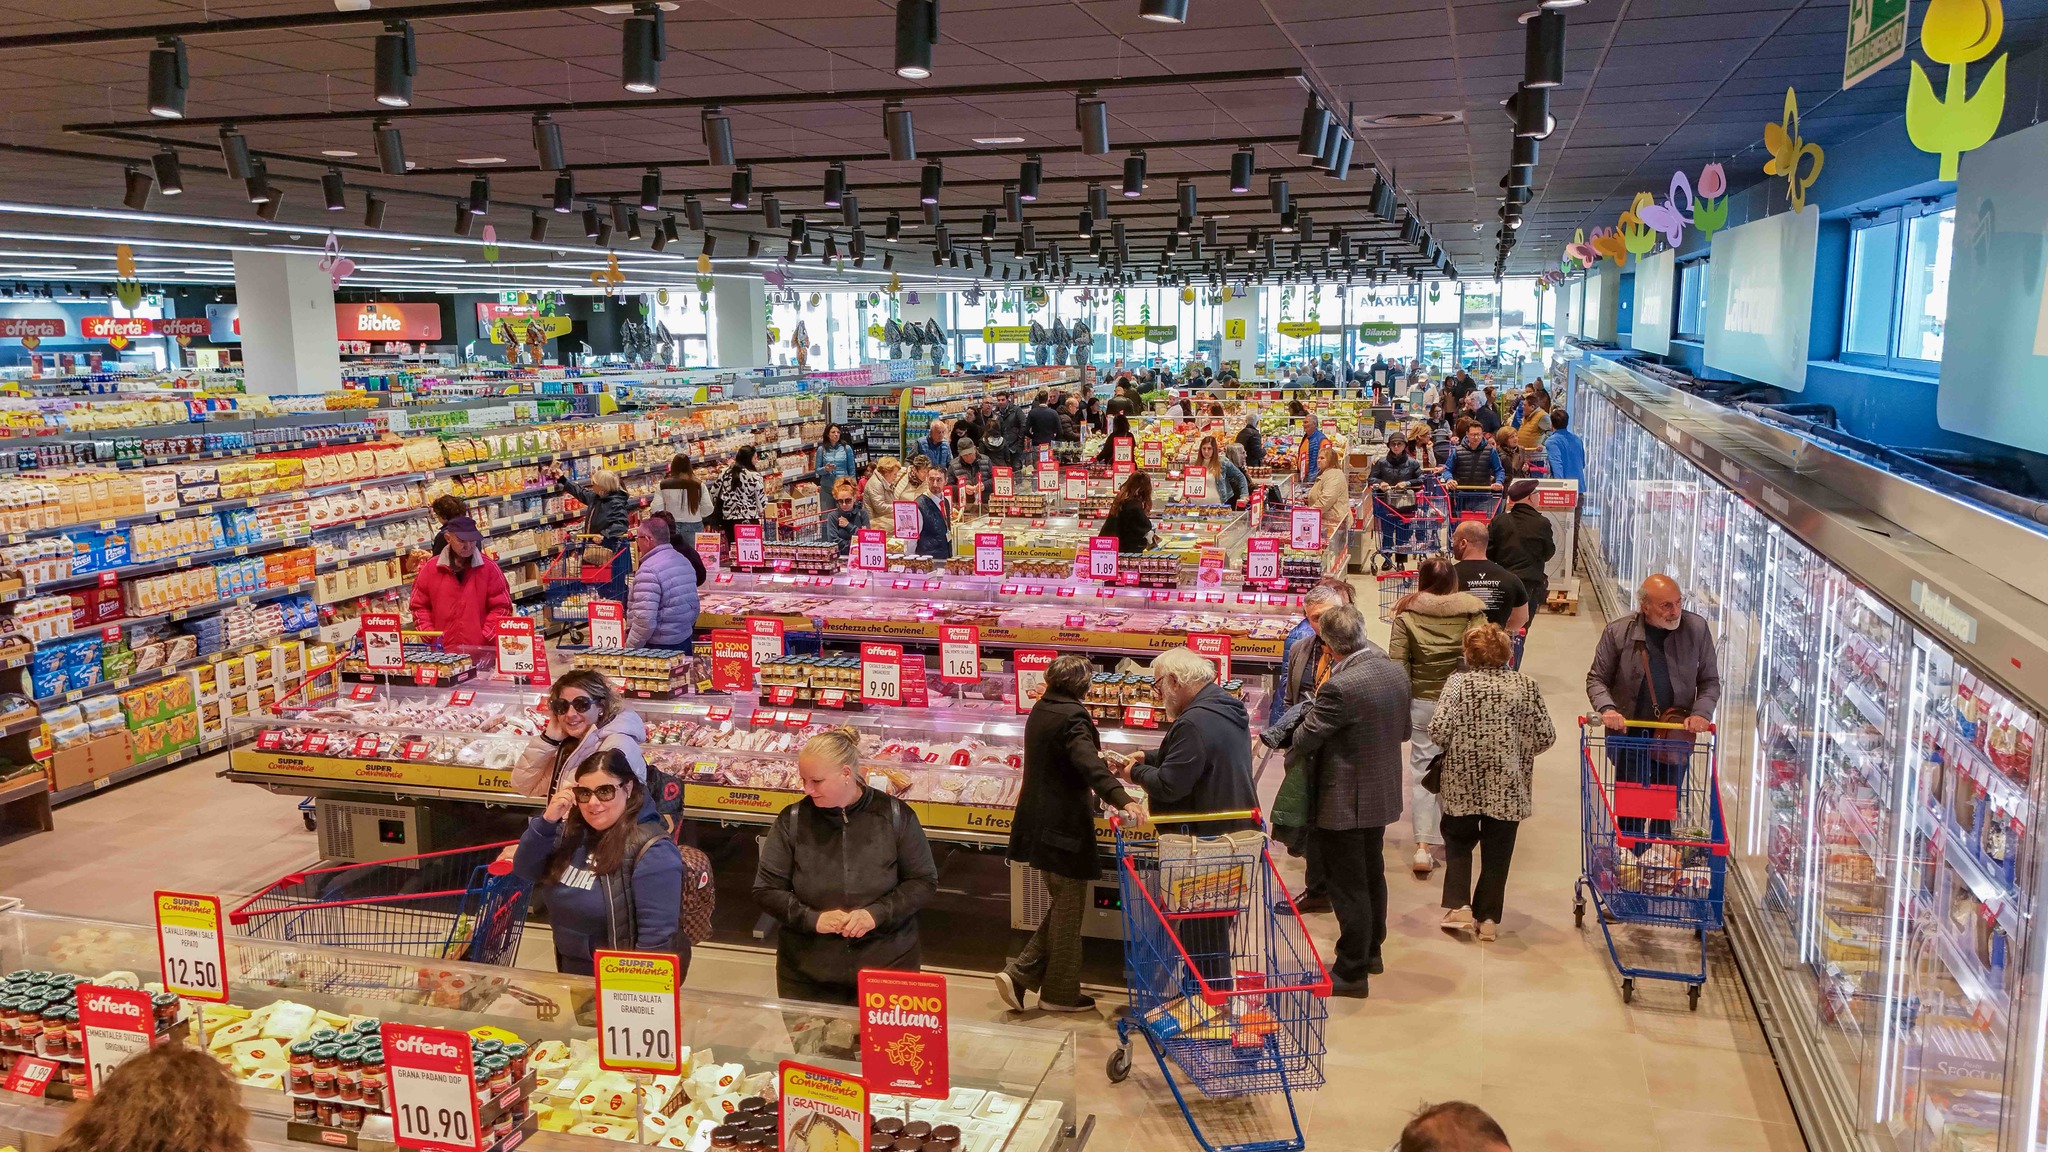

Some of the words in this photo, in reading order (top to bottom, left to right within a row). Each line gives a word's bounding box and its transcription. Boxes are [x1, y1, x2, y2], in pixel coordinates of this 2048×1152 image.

[5, 320, 54, 336] offerta
[94, 319, 142, 335] offerta
[162, 320, 203, 335] offerta
[358, 314, 402, 332] Bibite
[1148, 329, 1174, 337] Bilancia
[1365, 328, 1397, 337] Bilancia
[105, 549, 126, 562] Pavesi
[1018, 549, 1029, 557] che
[1030, 549, 1062, 558] Conviene!
[367, 617, 395, 627] offerta
[500, 621, 529, 631] offerta
[867, 624, 882, 633] che
[883, 624, 925, 635] Conviene!
[947, 628, 971, 636] prezzi
[980, 631, 1017, 639] Conveniente
[597, 635, 618, 649] 329
[949, 634, 969, 643] fermi
[1050, 635, 1089, 643] Conveniente
[1149, 638, 1161, 647] La
[1161, 639, 1188, 649] fresch
[1197, 638, 1222, 646] prezzi
[714, 642, 724, 650] IO
[725, 643, 750, 651] SONO
[867, 646, 897, 657] offerta
[1198, 644, 1221, 652] fermi
[716, 647, 749, 659] siciliano
[1021, 654, 1051, 664] offerta
[278, 757, 304, 766] SUPER
[268, 762, 314, 773] Conveniente
[365, 764, 392, 772] SUPER
[355, 768, 403, 779] Conveniente
[478, 774, 490, 787] La
[729, 791, 760, 801] SUPER
[717, 796, 772, 808] Conveniente
[967, 813, 984, 828] La
[173, 898, 200, 907] SUPER
[163, 902, 212, 915] Conveniente
[181, 939, 198, 948] PEPATO
[619, 959, 655, 968] SUPER
[168, 956, 217, 987] 12,50
[605, 965, 668, 977] Conveniente
[613, 993, 638, 1002] RICOTTA
[638, 995, 662, 1004] SALATA
[865, 992, 885, 1009] IO
[888, 994, 942, 1013] SONO
[88, 996, 140, 1017] offerta
[621, 1005, 654, 1015] GRANOBILE
[868, 1004, 939, 1028] siciliano
[86, 1028, 123, 1040] EMMENTALER
[105, 1042, 132, 1053] ORIGINALE
[395, 1035, 458, 1058] offerta
[608, 1026, 670, 1060] 11,90
[397, 1069, 421, 1080] GRANA
[422, 1072, 447, 1083] PADANO
[448, 1075, 462, 1085] DOP
[804, 1071, 843, 1087] SUPER
[789, 1074, 858, 1099] Conveniente
[787, 1096, 792, 1106] I
[792, 1096, 861, 1122] GRATTUGIATI
[401, 1103, 468, 1141] 10,90
